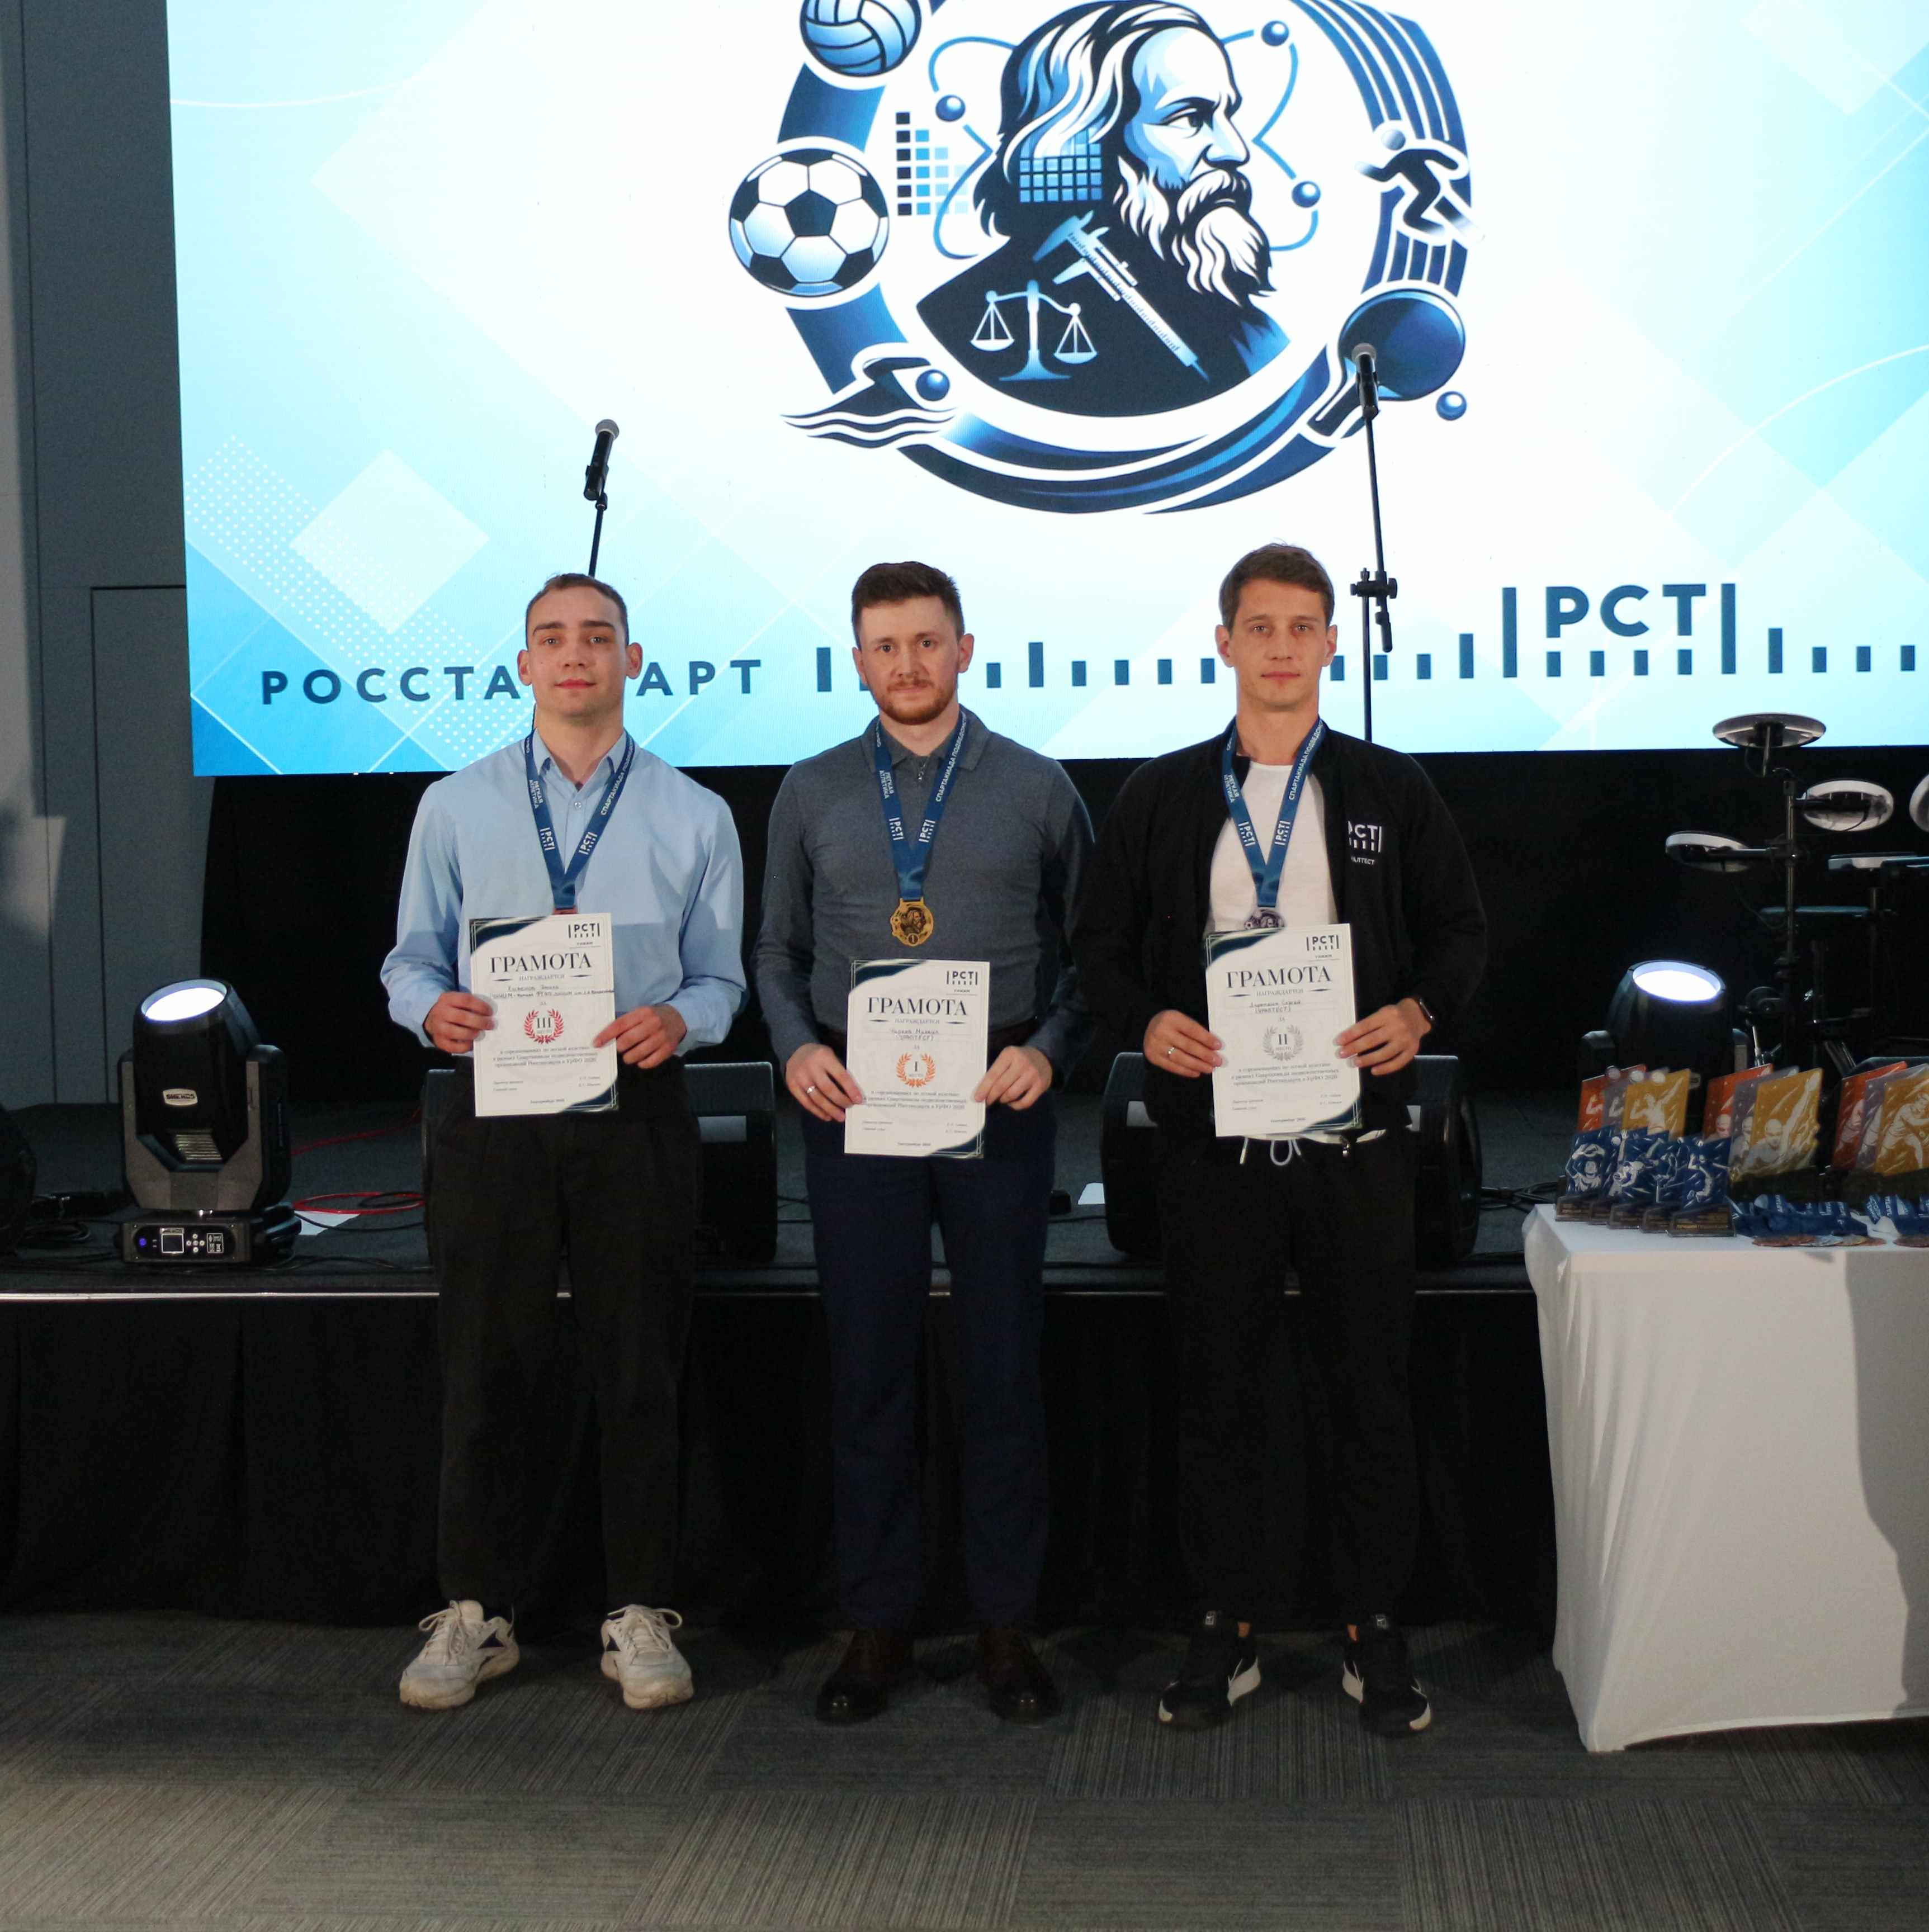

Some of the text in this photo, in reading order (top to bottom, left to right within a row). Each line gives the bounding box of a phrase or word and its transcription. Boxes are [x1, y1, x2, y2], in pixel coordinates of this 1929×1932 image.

[1546, 584, 1706, 638] РСТ
[262, 659, 761, 704] РОССТААРТ
[574, 923, 596, 932] РСТ
[1312, 935, 1334, 945] РСТ
[490, 952, 592, 973] ГРАМОТА
[952, 970, 974, 979] РСТ
[1226, 965, 1332, 989] ГРАМОТА
[867, 997, 968, 1016] ГРАМОТА
[537, 1017, 551, 1029] III
[1278, 1034, 1288, 1045] II
